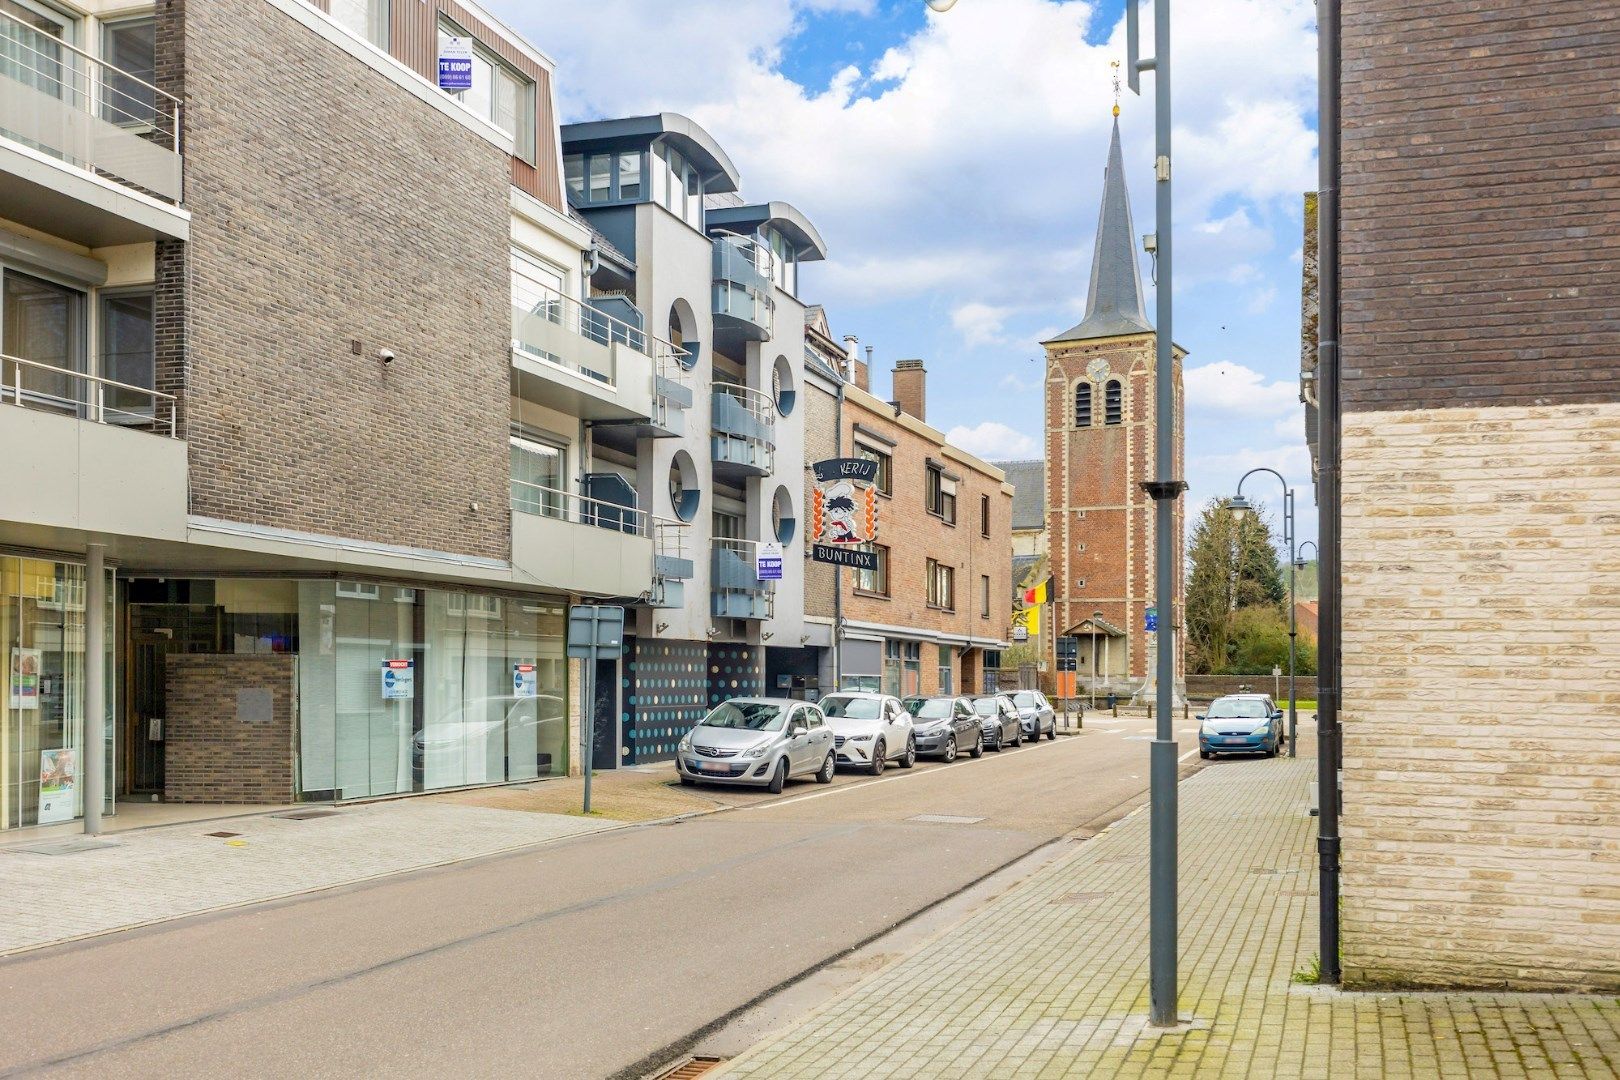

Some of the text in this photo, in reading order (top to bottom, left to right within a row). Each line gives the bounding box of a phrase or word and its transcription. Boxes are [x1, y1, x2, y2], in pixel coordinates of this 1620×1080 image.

[440, 62, 471, 72] TE KOOP
[818, 546, 871, 567] BUNTINX
